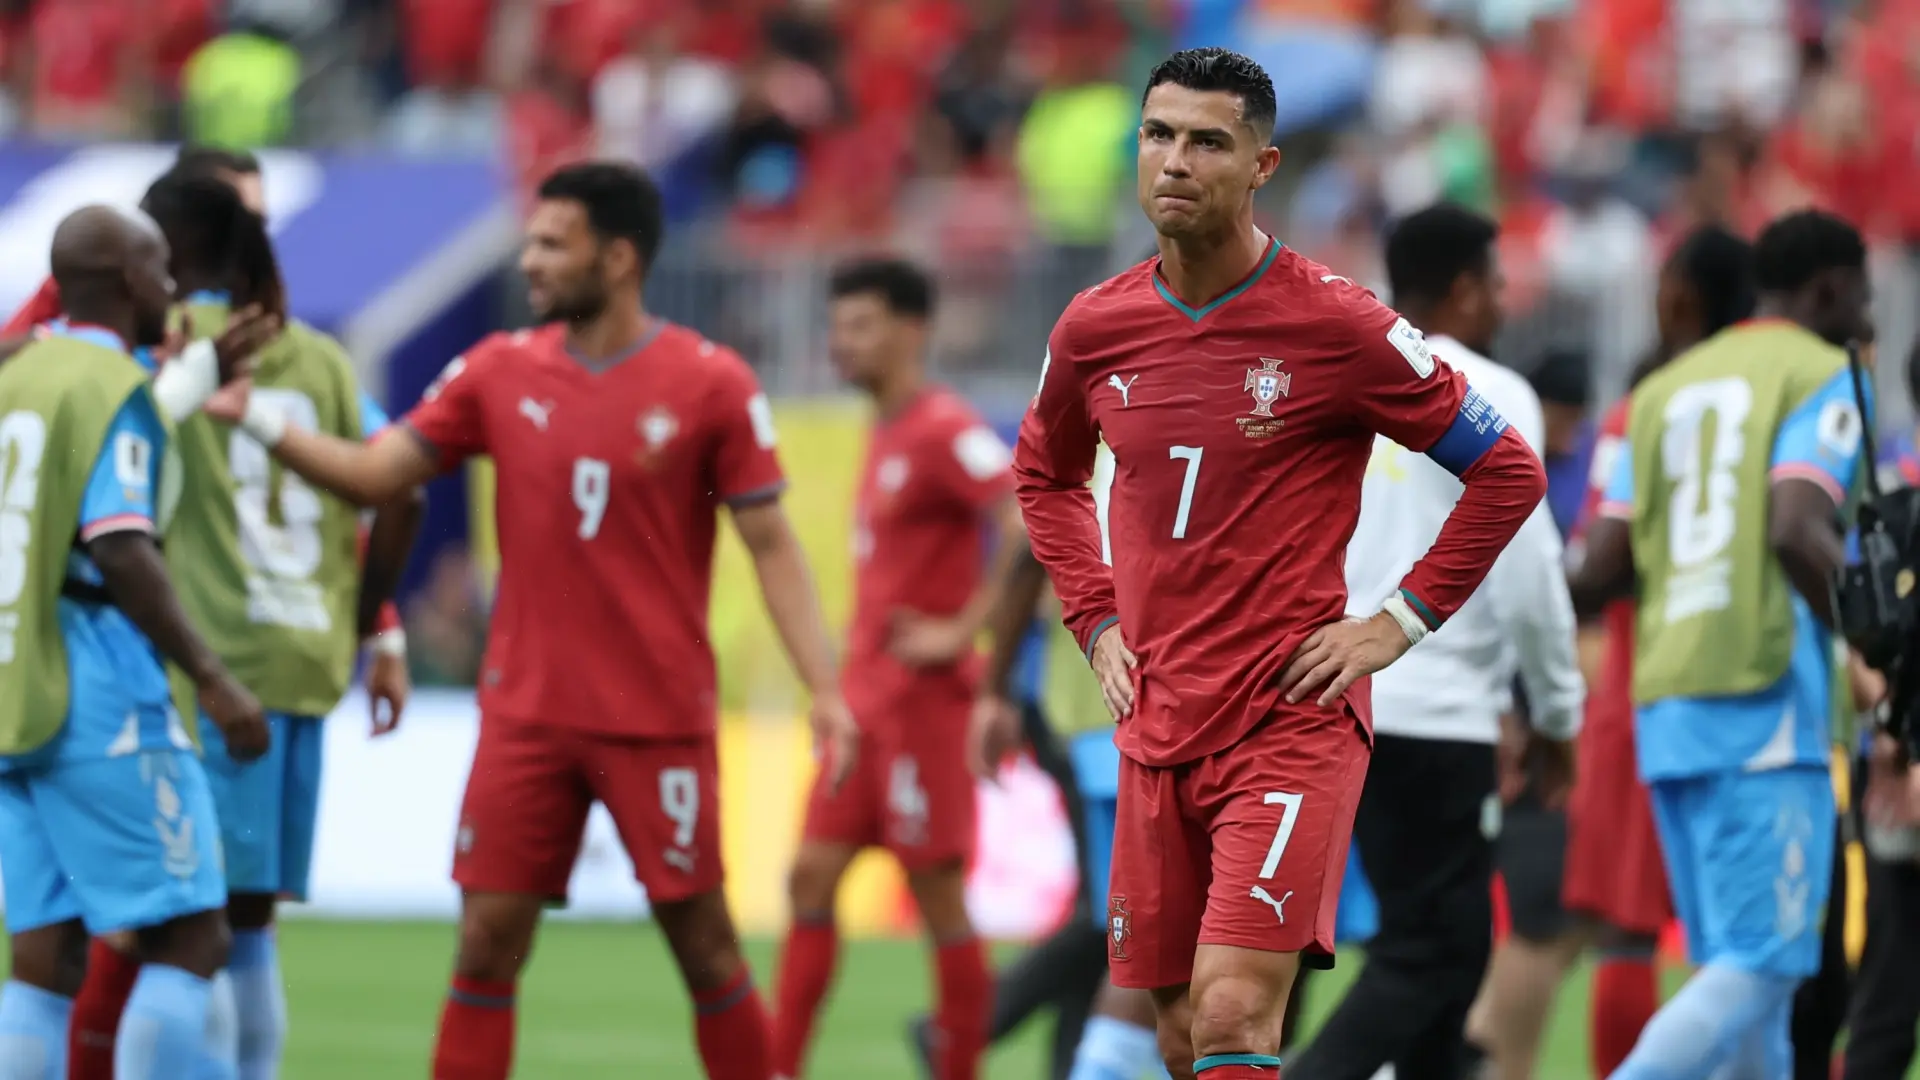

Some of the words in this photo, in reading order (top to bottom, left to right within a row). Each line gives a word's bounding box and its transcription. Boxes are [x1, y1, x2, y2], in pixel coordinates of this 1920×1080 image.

[1474, 418, 1491, 435] the
[572, 456, 611, 541] 9
[1169, 445, 1204, 539] 7
[658, 766, 699, 847] 9
[1258, 791, 1304, 879] 7
